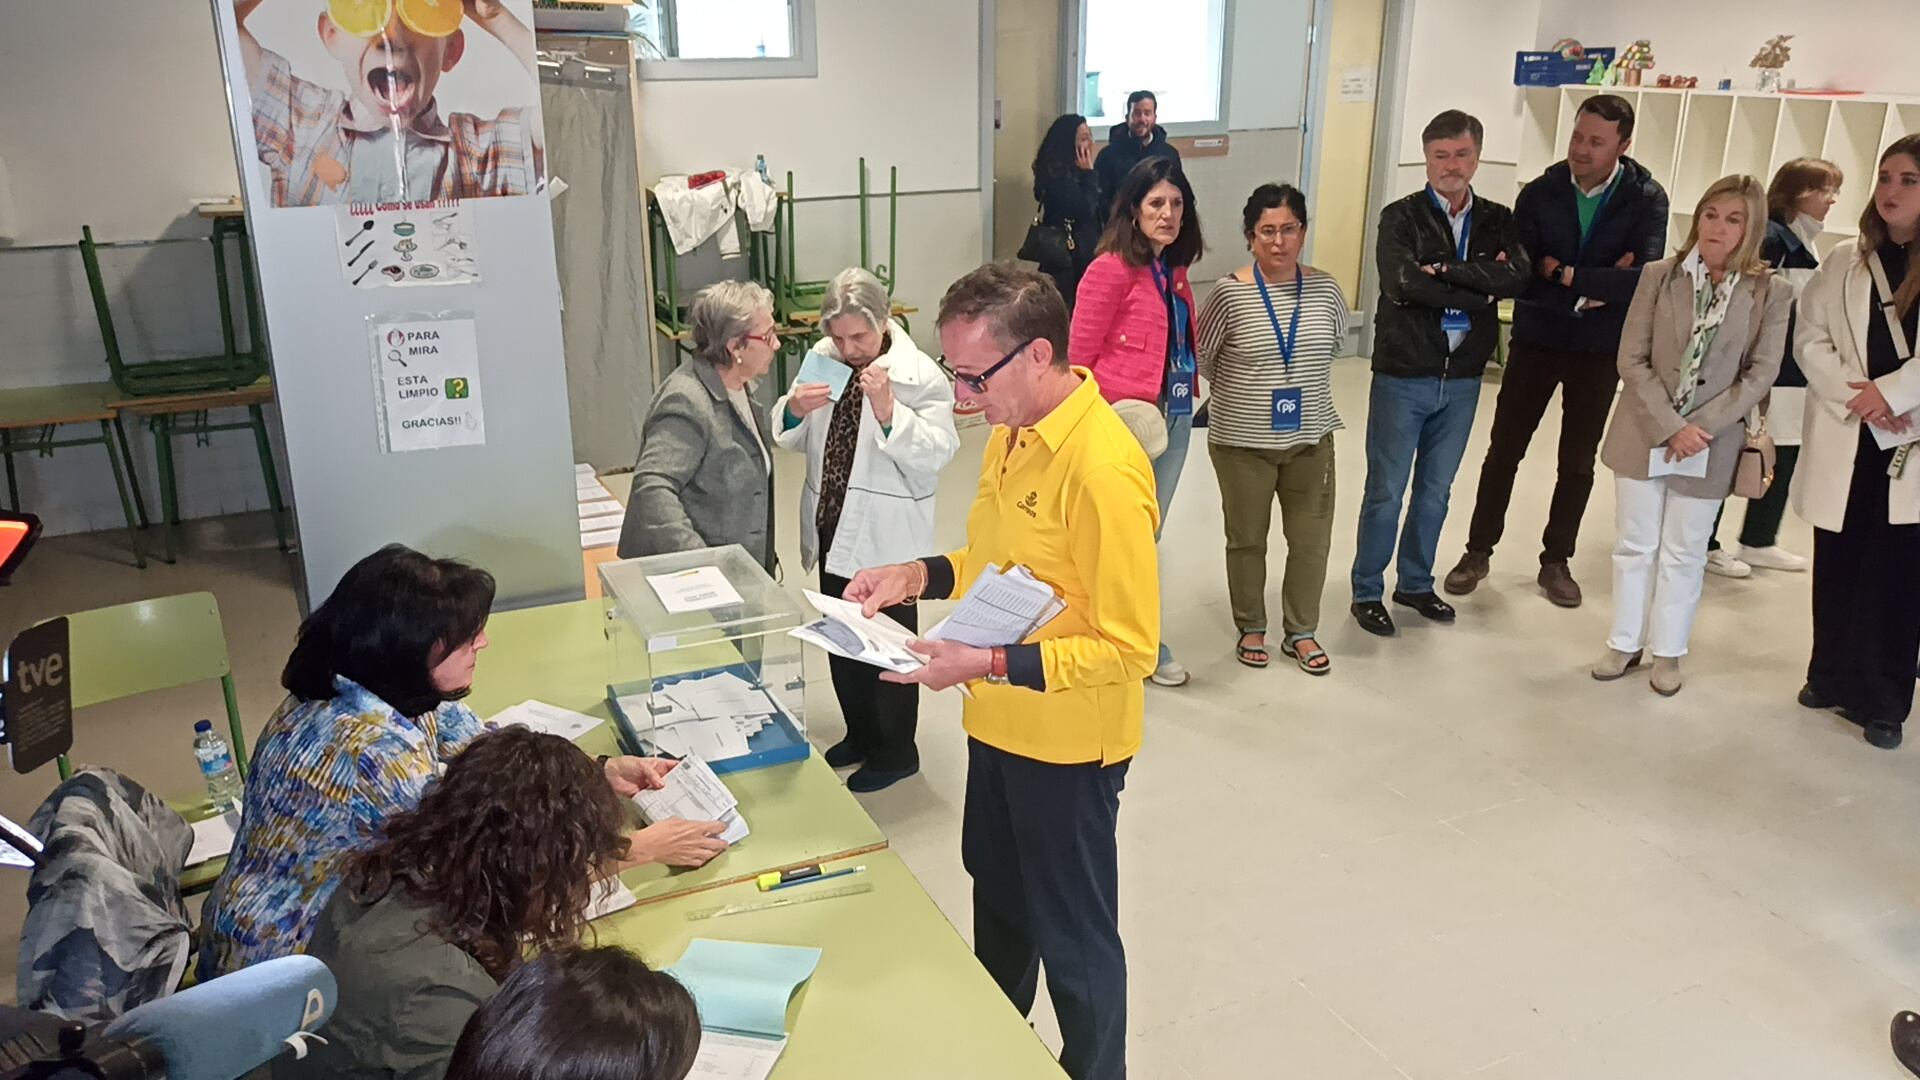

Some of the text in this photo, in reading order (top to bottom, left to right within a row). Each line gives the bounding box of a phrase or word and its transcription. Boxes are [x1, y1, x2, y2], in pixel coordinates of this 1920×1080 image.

[407, 331, 440, 341] PARA
[408, 345, 439, 356] MIRA
[397, 375, 428, 386] ESTA
[398, 387, 439, 399] LIMPIO
[401, 416, 462, 429] GRACIAS!!
[17, 653, 63, 693] tve
